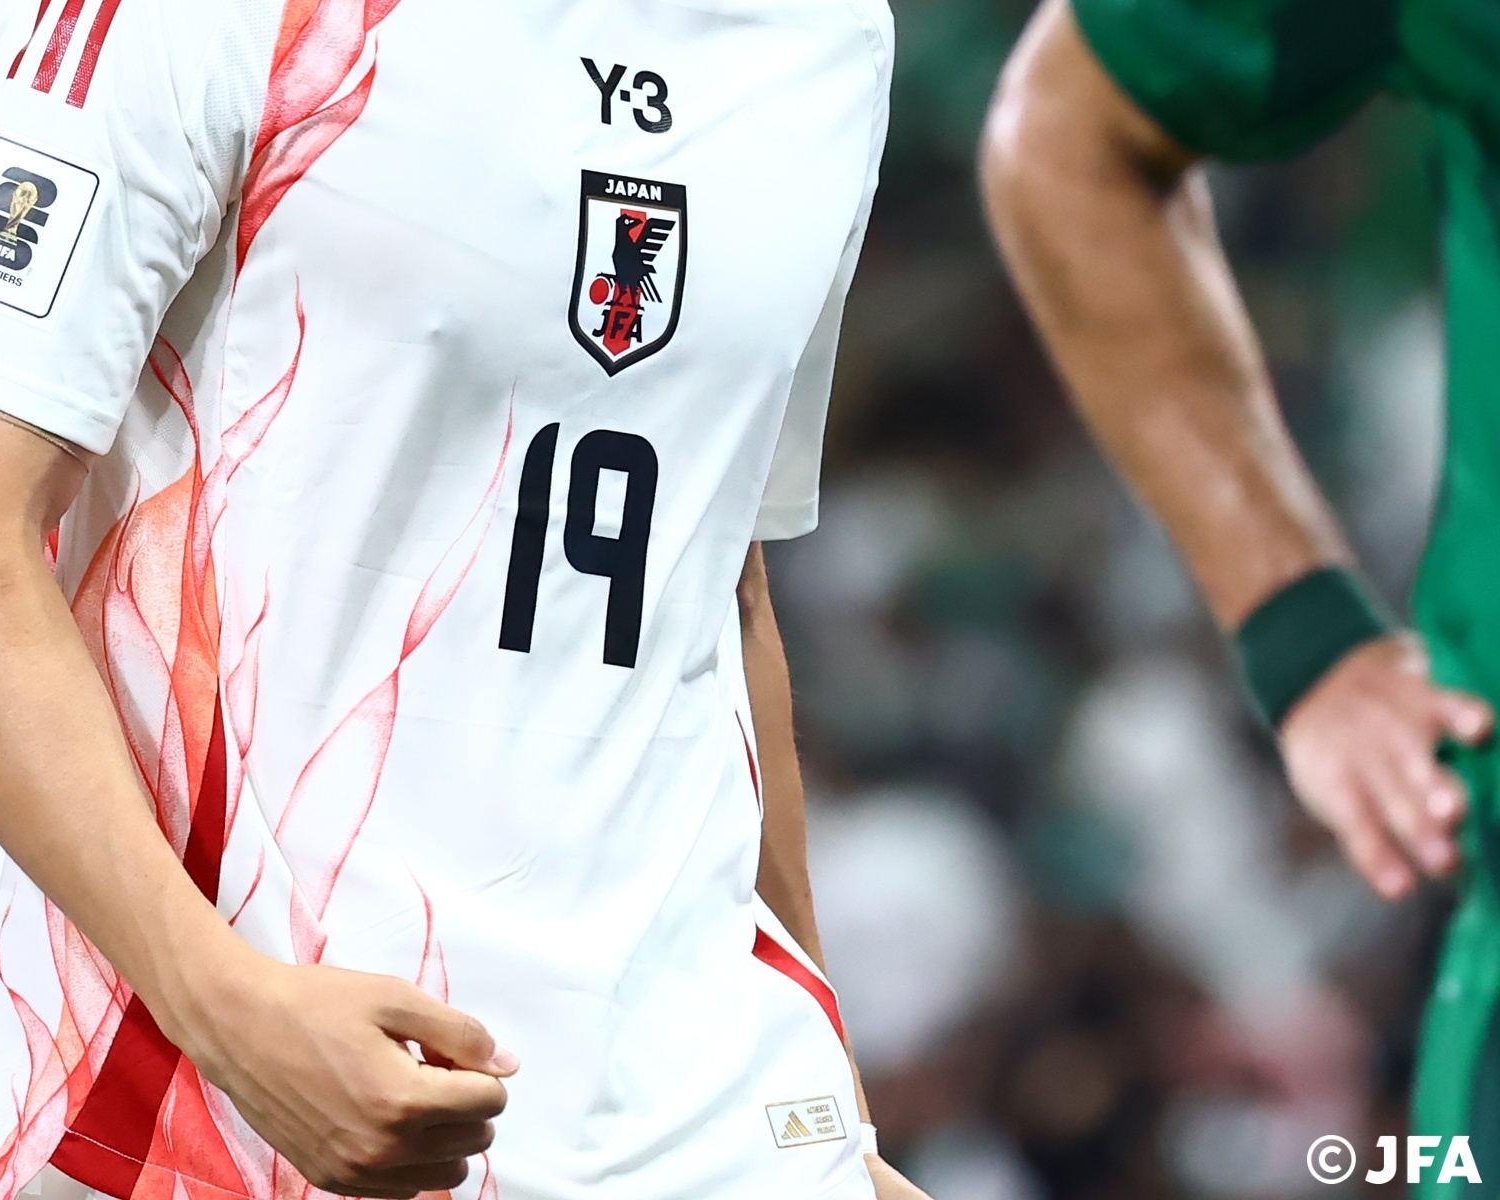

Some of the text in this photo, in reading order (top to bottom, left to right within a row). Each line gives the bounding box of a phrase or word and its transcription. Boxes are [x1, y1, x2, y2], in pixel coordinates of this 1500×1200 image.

[580, 56, 673, 134] Y-3
[604, 178, 663, 201] JAPAN
[591, 307, 643, 343] JFA
[498, 421, 659, 669] 19
